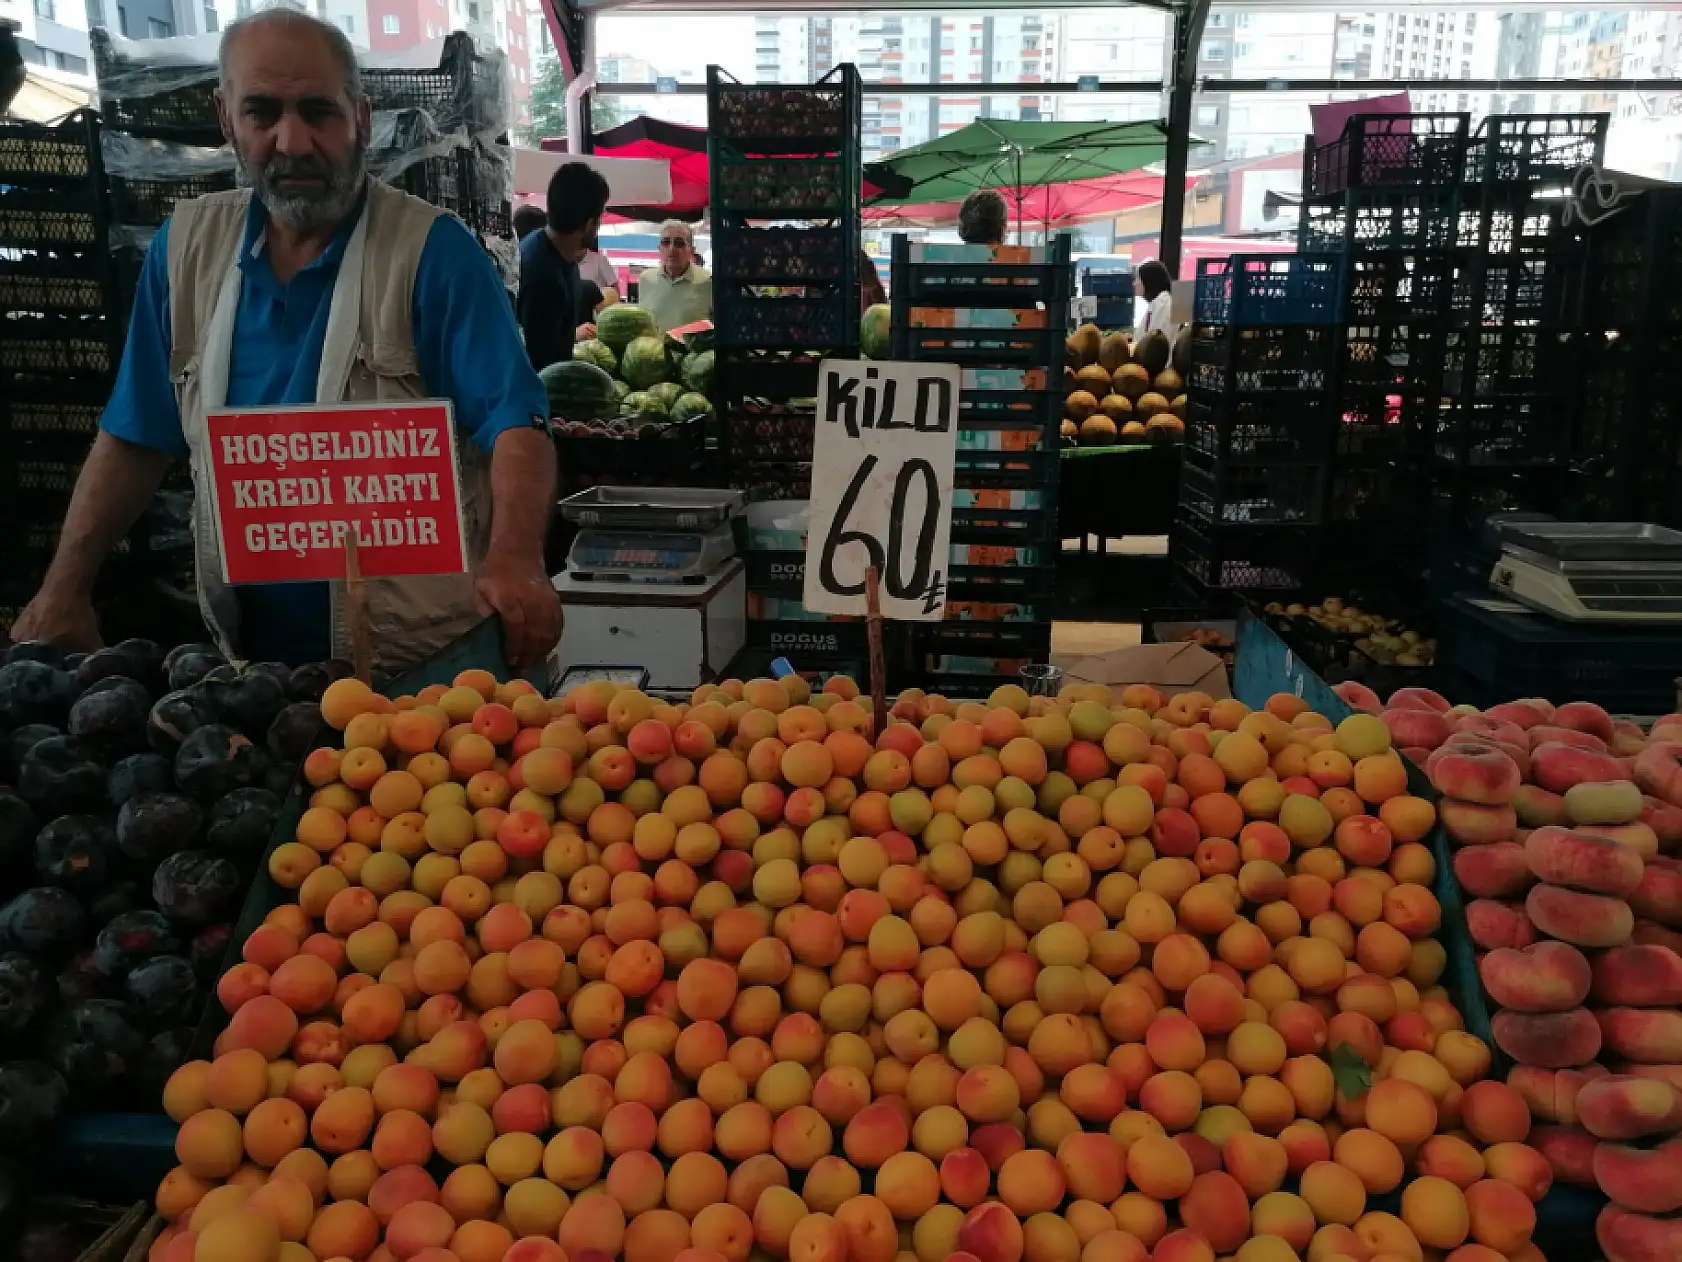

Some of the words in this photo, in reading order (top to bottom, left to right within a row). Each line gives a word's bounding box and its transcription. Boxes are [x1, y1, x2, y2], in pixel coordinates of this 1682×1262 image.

[221, 421, 441, 470] HOŞGELDİNİZ
[232, 468, 333, 508] KREDİ
[343, 473, 441, 504] KARTI
[245, 511, 439, 558] GEÇERLİDİR
